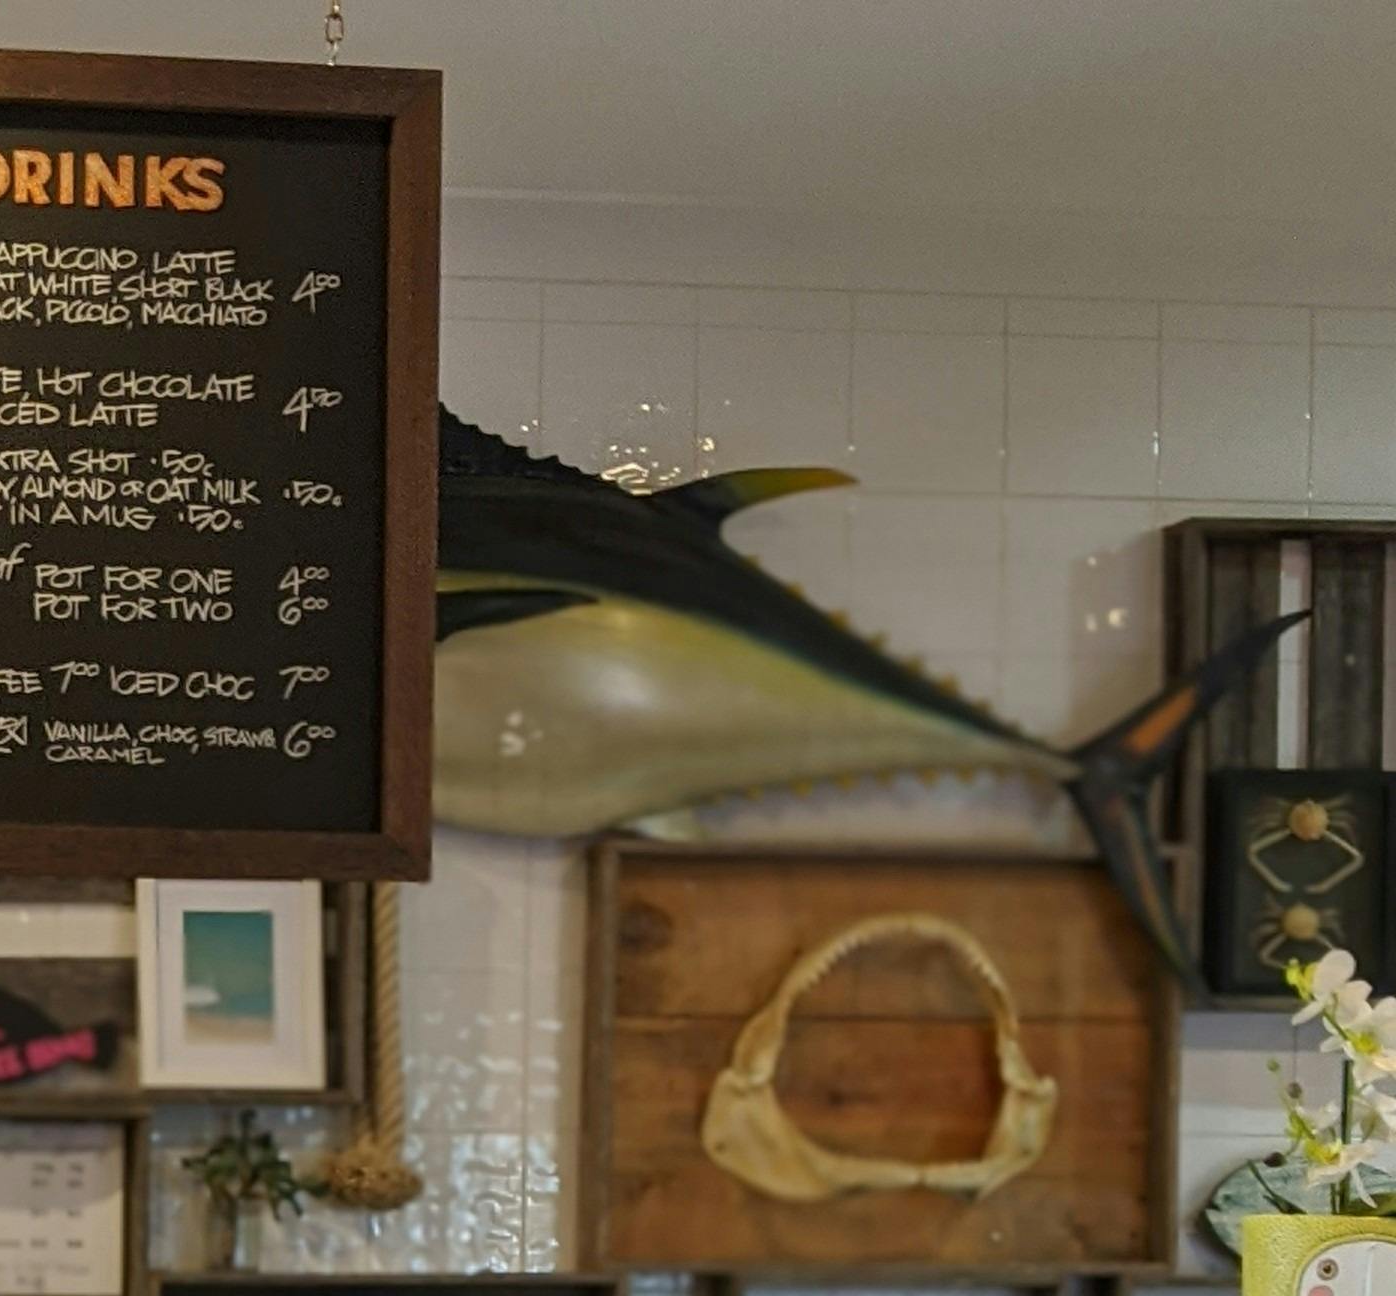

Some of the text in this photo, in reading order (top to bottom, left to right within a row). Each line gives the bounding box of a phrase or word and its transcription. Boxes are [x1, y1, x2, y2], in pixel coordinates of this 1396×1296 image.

[153, 250, 236, 275] LATTE
[117, 272, 199, 301] SHORT
[206, 276, 275, 302] BLACK
[46, 299, 133, 329] PICCOLO,
[141, 301, 269, 327] MACCHIATO
[36, 366, 93, 395] HOT
[100, 370, 255, 402] CHOCOLATE
[70, 401, 159, 427] LATTE
[68, 449, 137, 475] SHOT
[21, 473, 116, 502] ALMOND
[146, 476, 199, 504] OAT
[203, 478, 262, 505] MILK
[10, 502, 41, 526] IN
[50, 500, 79, 526] A
[81, 504, 157, 531] MUG
[34, 563, 95, 589] POT
[104, 565, 162, 591] FOR
[170, 568, 233, 595] ONE
[33, 592, 91, 621] POT
[101, 592, 157, 622] FOR
[159, 596, 234, 622] TWO
[110, 665, 180, 697] ICED
[185, 671, 255, 701] CHOC
[44, 720, 139, 747] VANILLA,
[138, 724, 200, 754] CHOC,
[45, 744, 166, 766] CARAMEL
